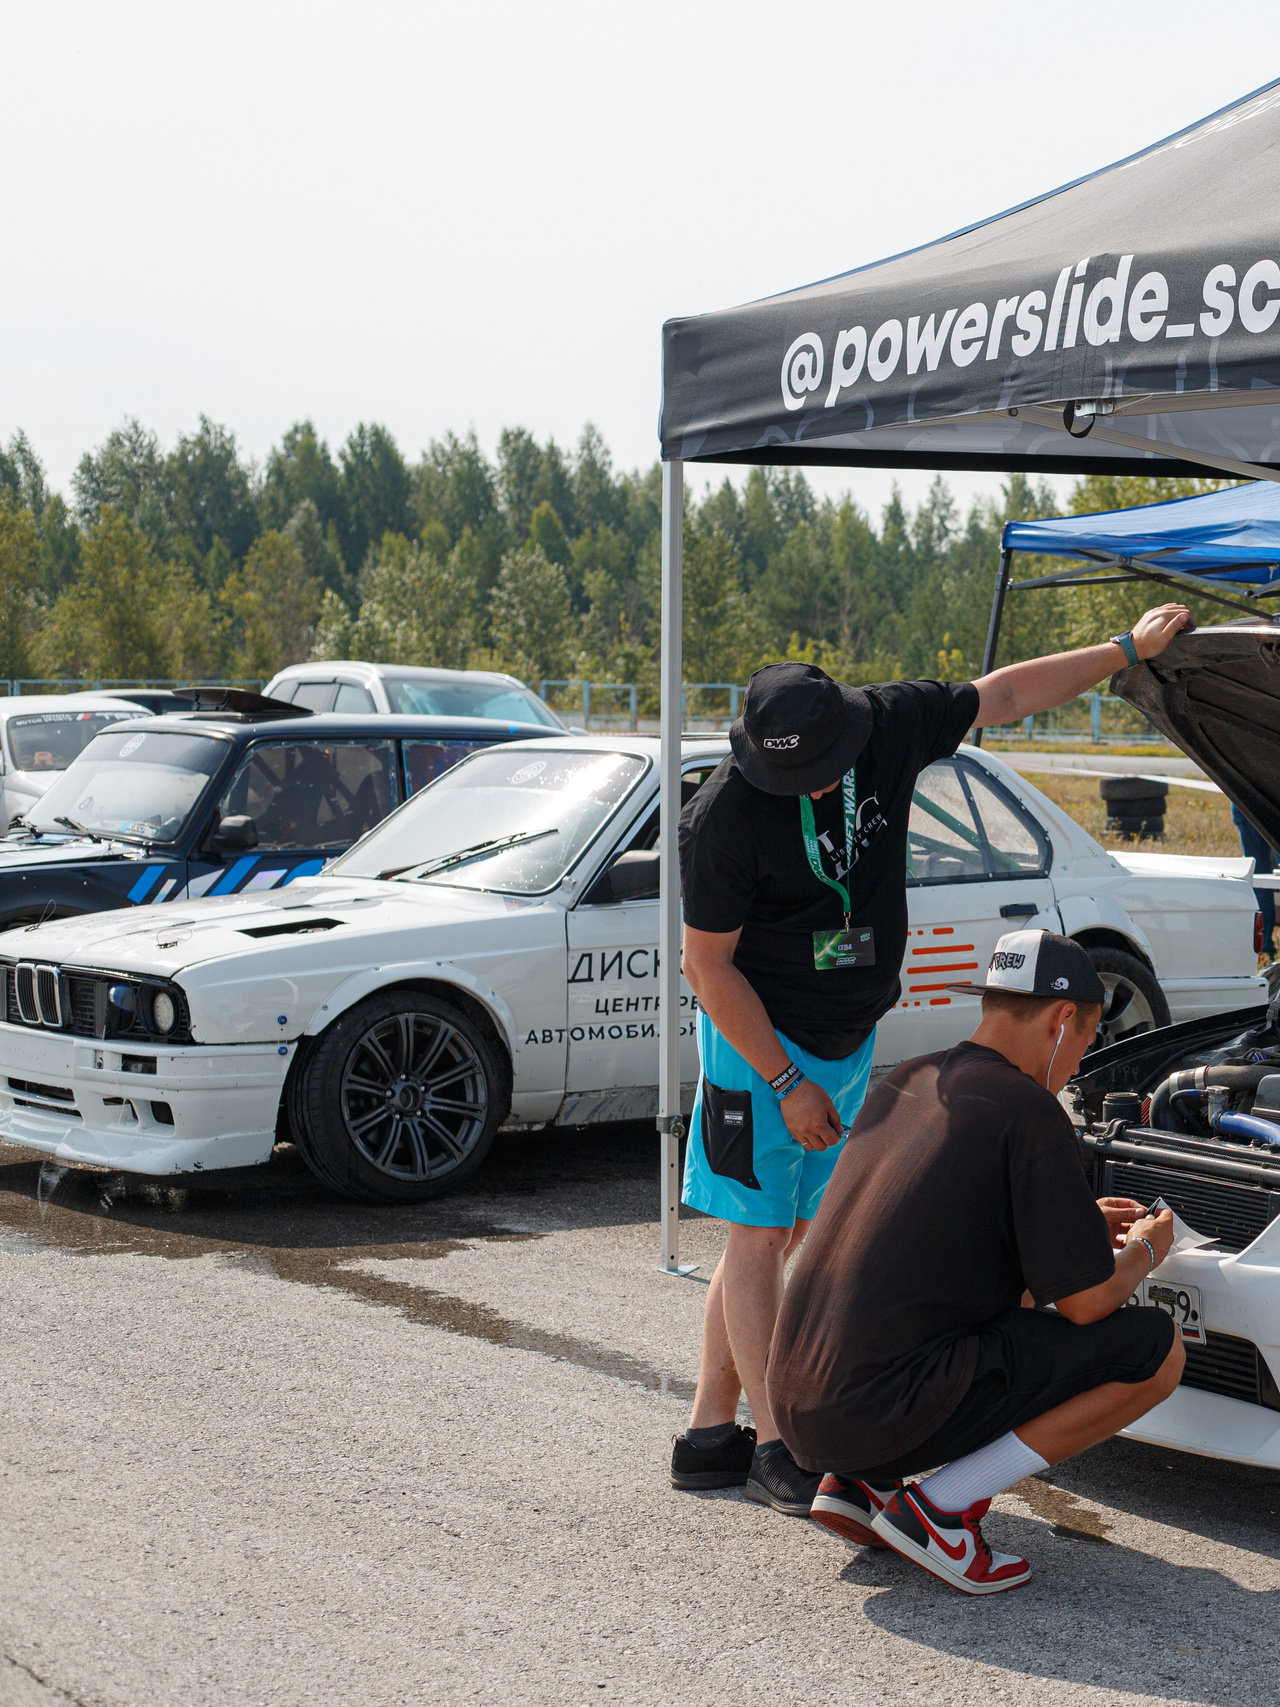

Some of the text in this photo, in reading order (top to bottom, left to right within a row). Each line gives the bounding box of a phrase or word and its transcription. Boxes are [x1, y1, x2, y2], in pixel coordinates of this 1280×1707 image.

[764, 734, 799, 749] DWC
[830, 812, 883, 862] LIBTY CREW
[771, 1072, 789, 1089] PERM
